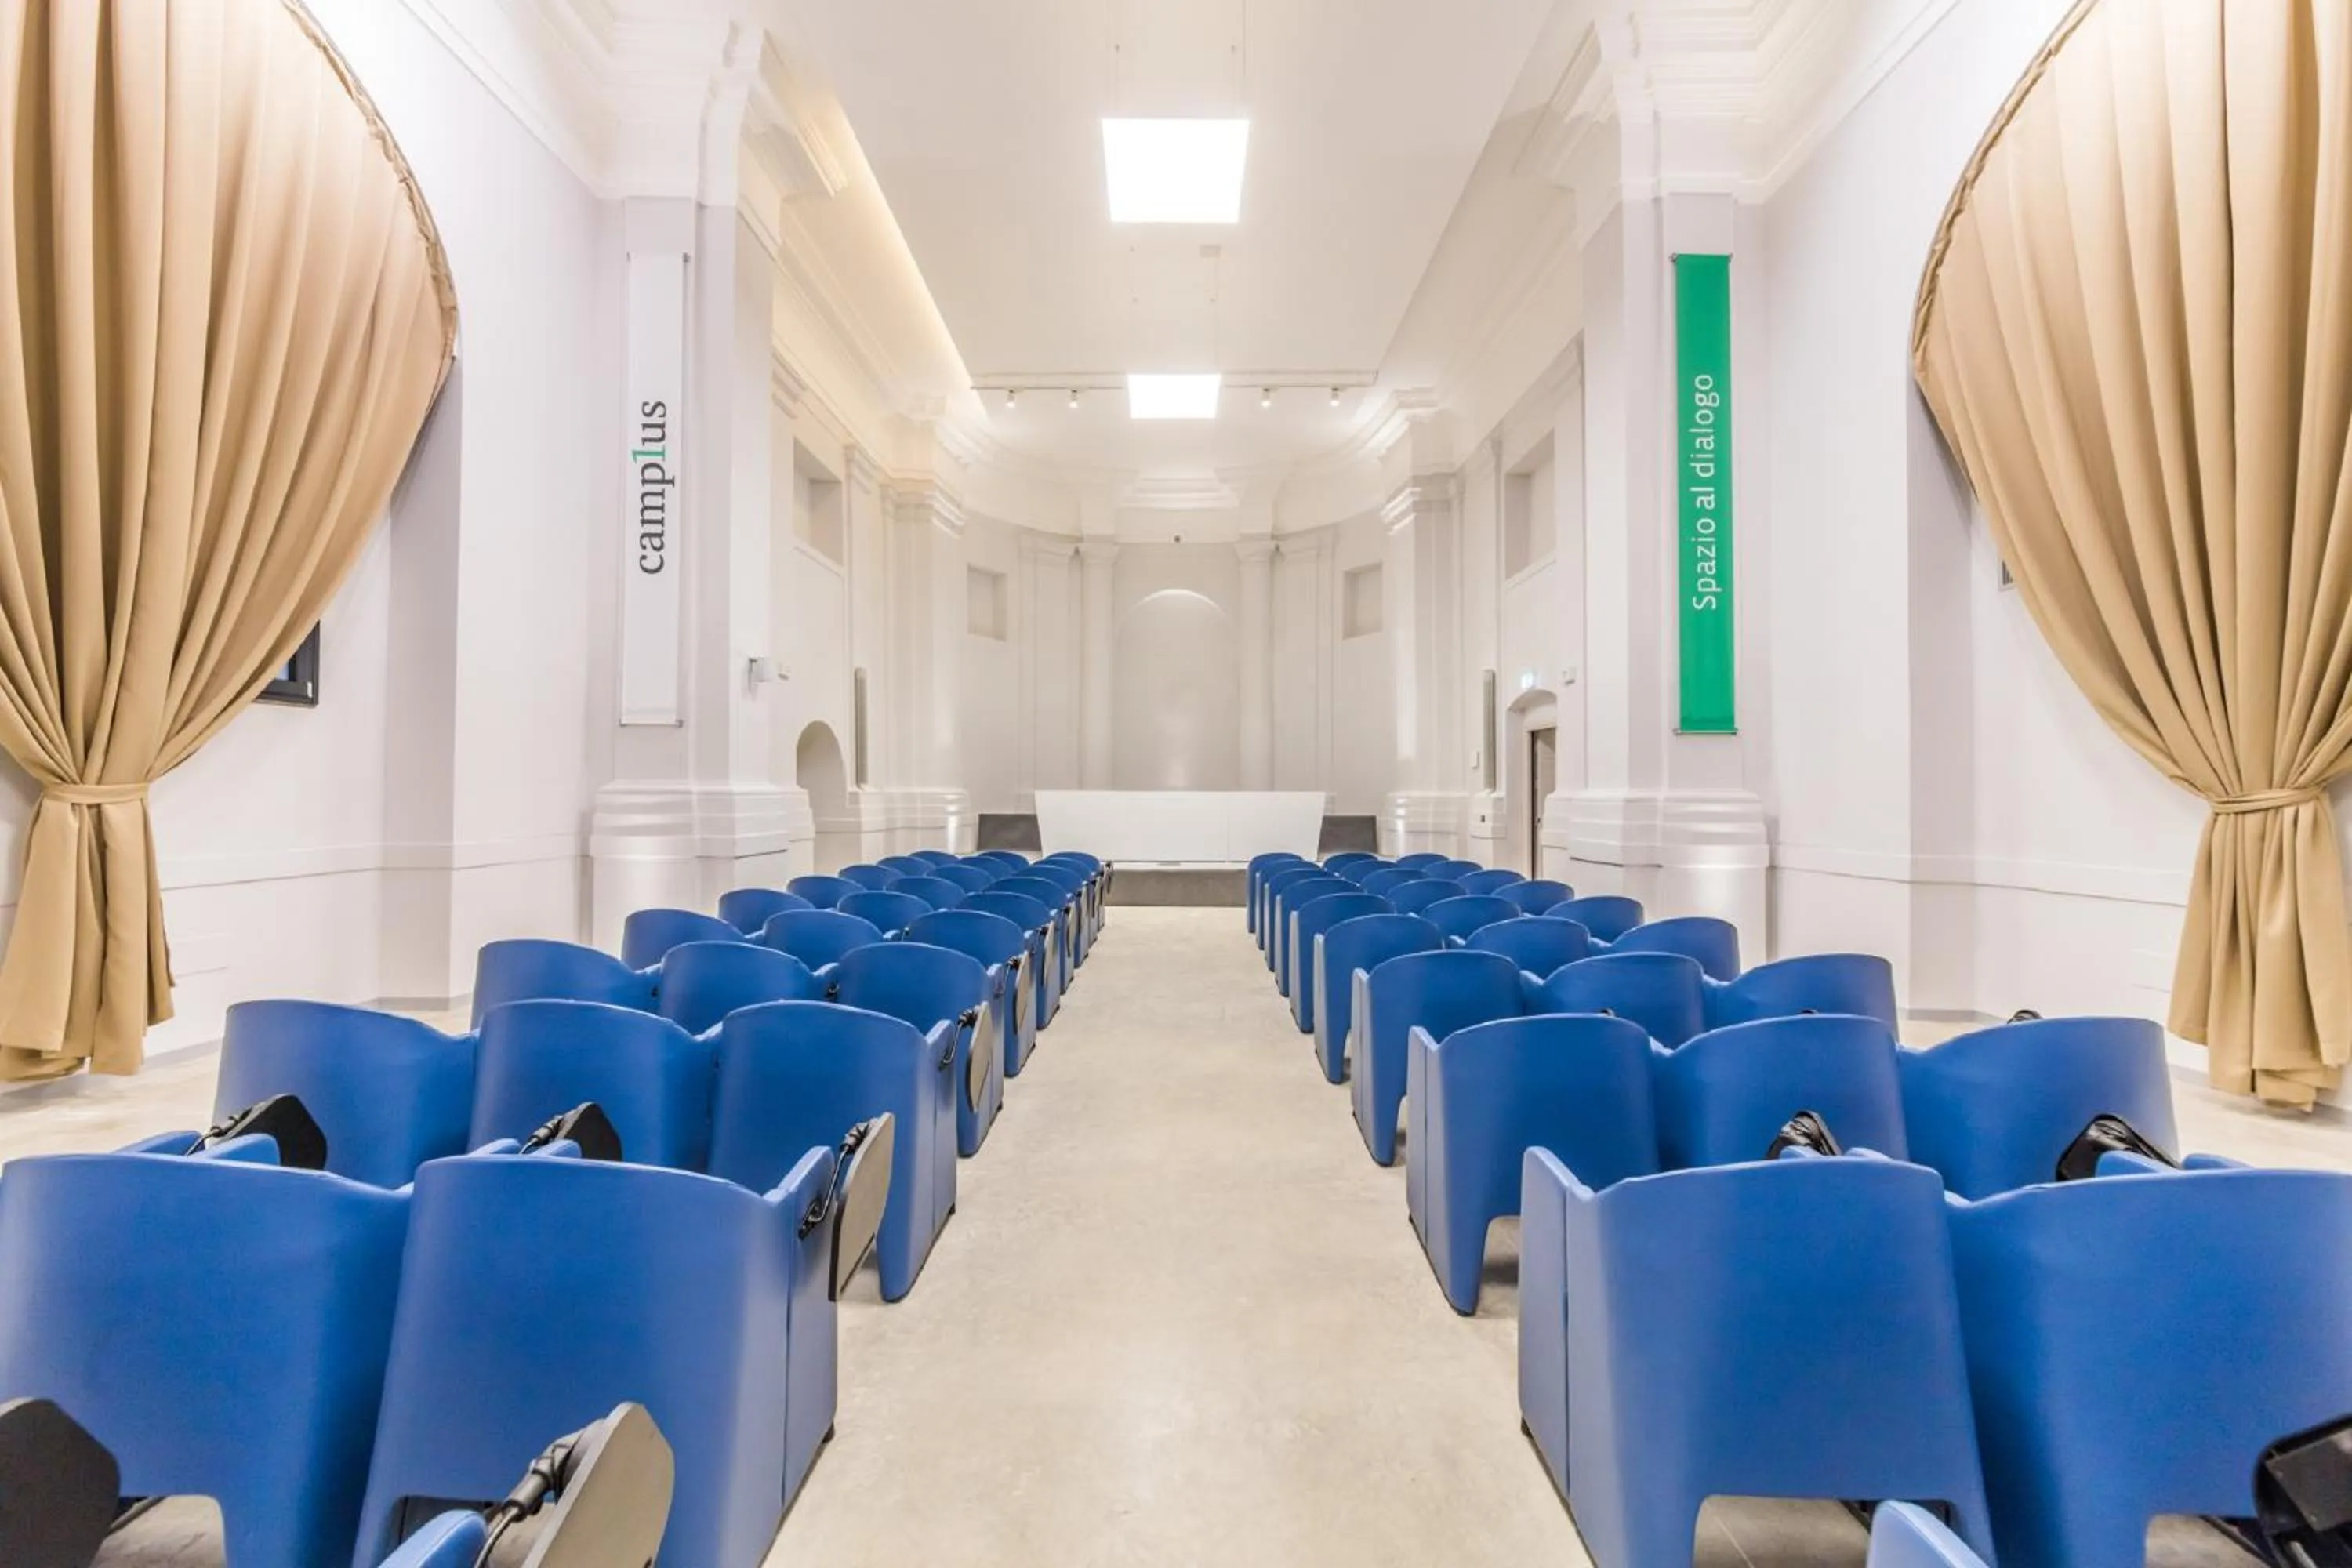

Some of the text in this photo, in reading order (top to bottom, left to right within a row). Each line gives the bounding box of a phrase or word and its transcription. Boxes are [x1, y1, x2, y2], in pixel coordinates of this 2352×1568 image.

[632, 401, 675, 574] camplus
[1688, 373, 1723, 610] Spazio al dialogo
